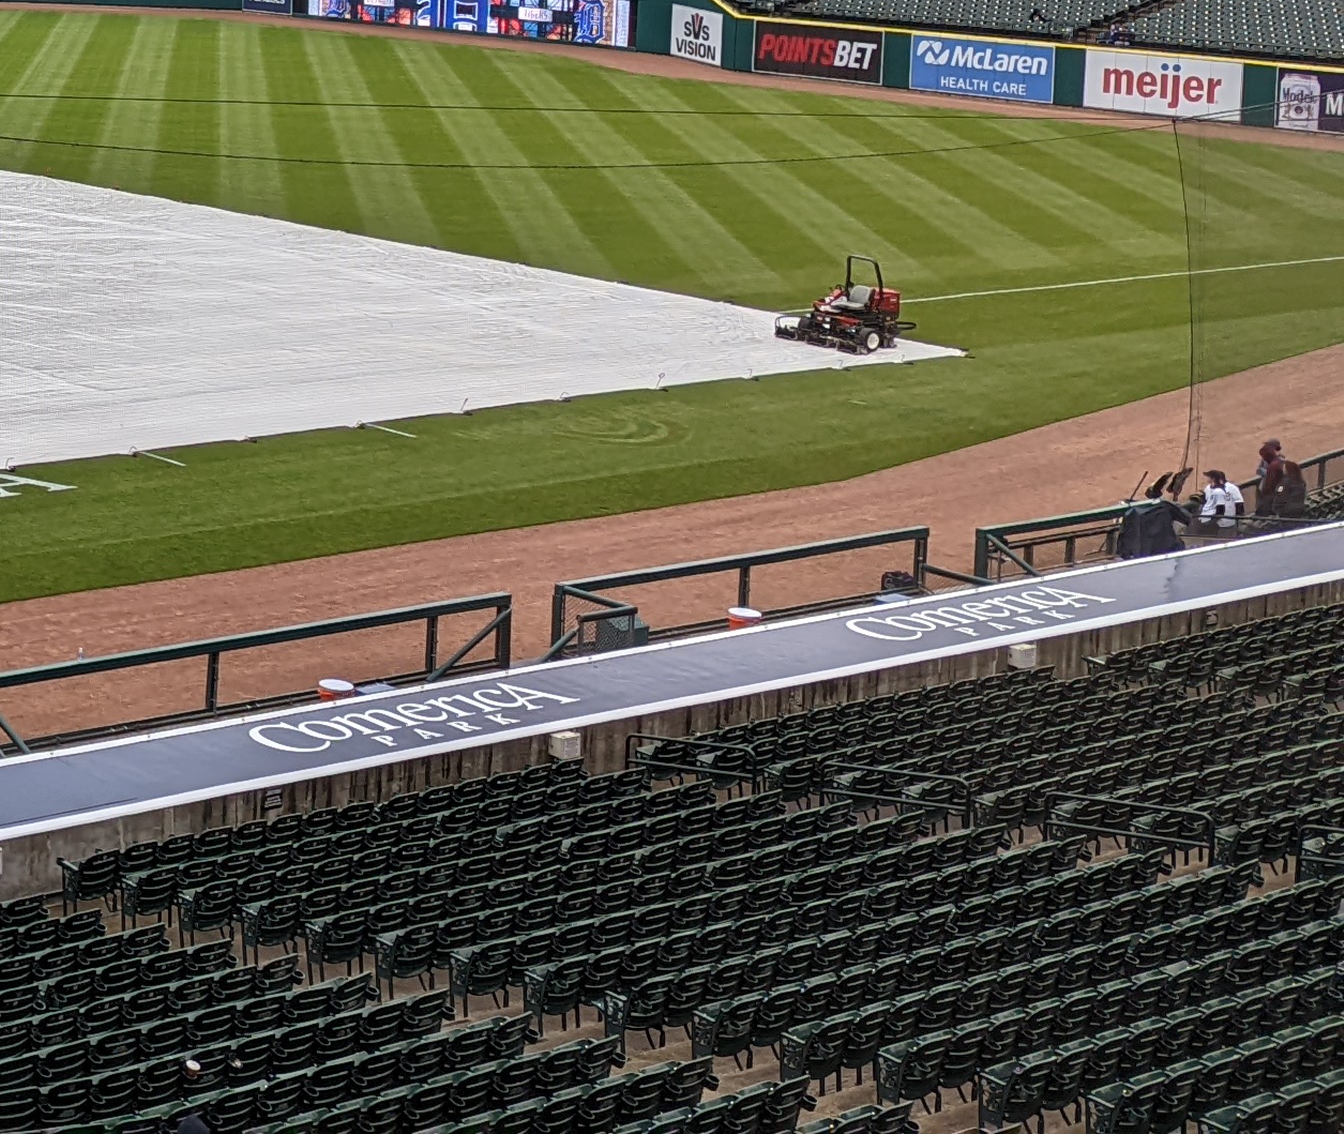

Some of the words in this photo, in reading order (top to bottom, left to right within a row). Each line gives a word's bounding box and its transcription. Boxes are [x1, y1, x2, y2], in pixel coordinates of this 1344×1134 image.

[675, 37, 717, 61] VISION
[758, 33, 878, 71] POINTSBET
[951, 46, 1048, 76] McLaren
[941, 76, 989, 92] HEALTH
[993, 79, 1027, 96] CARE
[1102, 63, 1223, 109] meijer
[954, 610, 1075, 636] PARK
[371, 713, 520, 747] PARK
